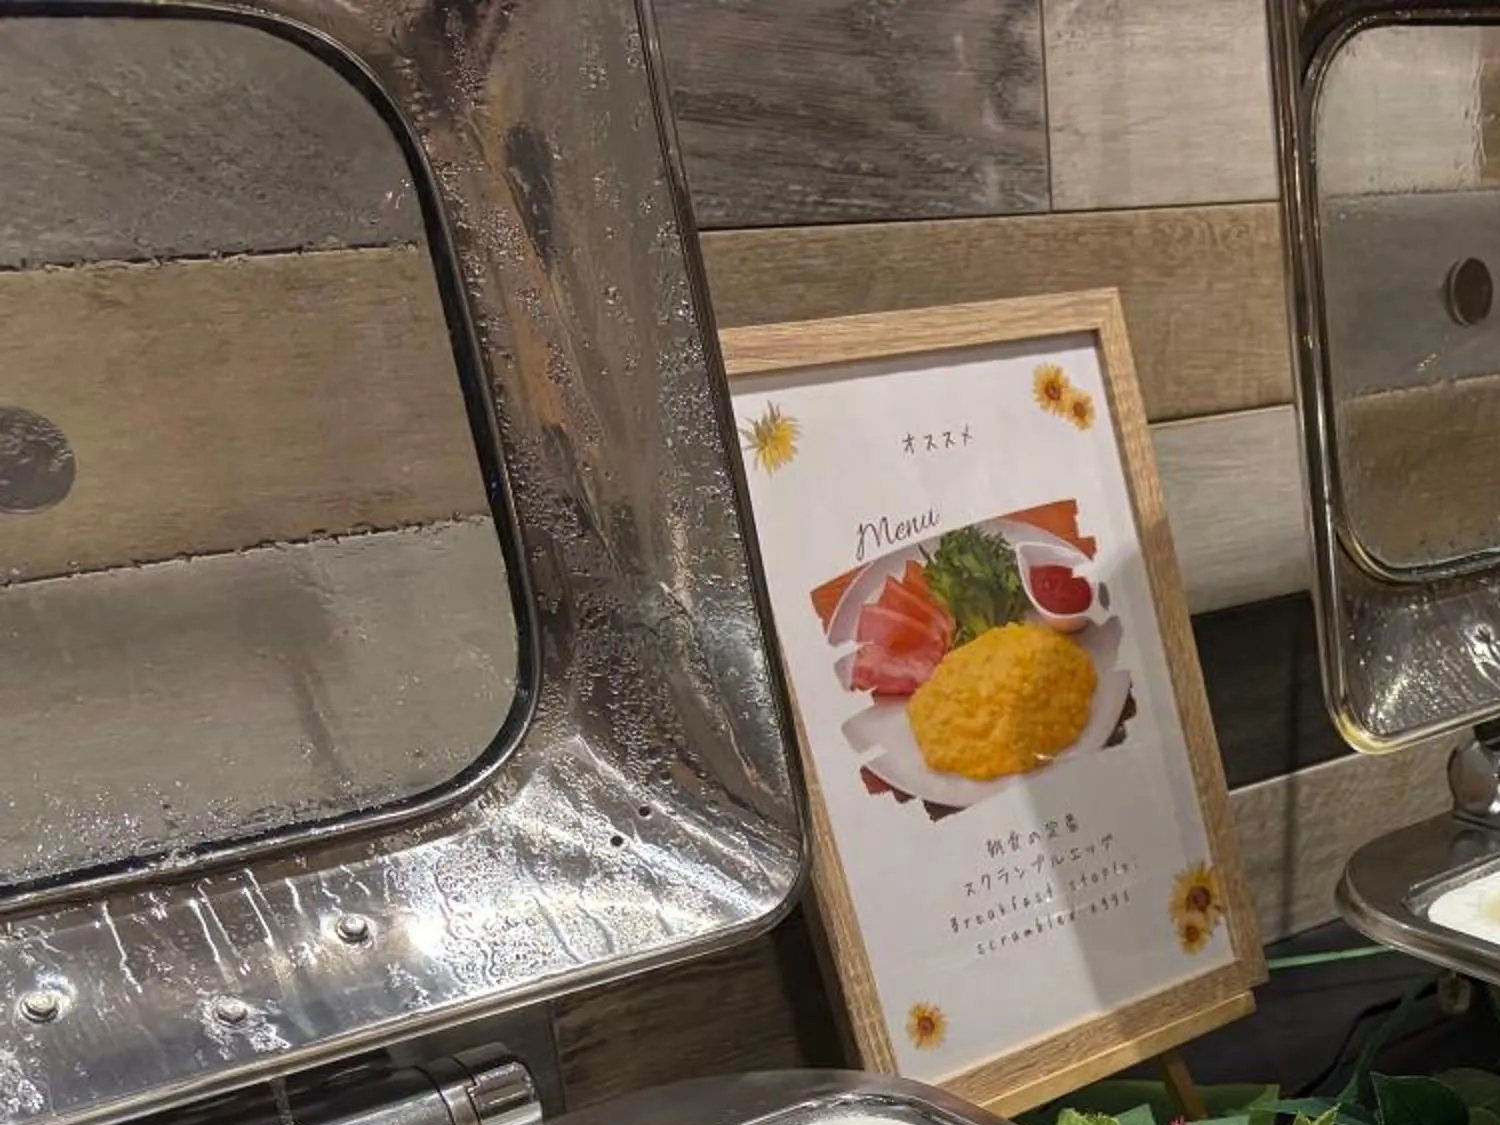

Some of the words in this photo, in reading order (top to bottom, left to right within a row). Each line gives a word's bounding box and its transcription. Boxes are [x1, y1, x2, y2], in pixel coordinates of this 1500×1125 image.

[902, 422, 973, 455] オススメ
[855, 506, 940, 561] Menu
[986, 813, 1079, 859] 朝食の定番
[963, 832, 1114, 897] スクランブルエッグ
